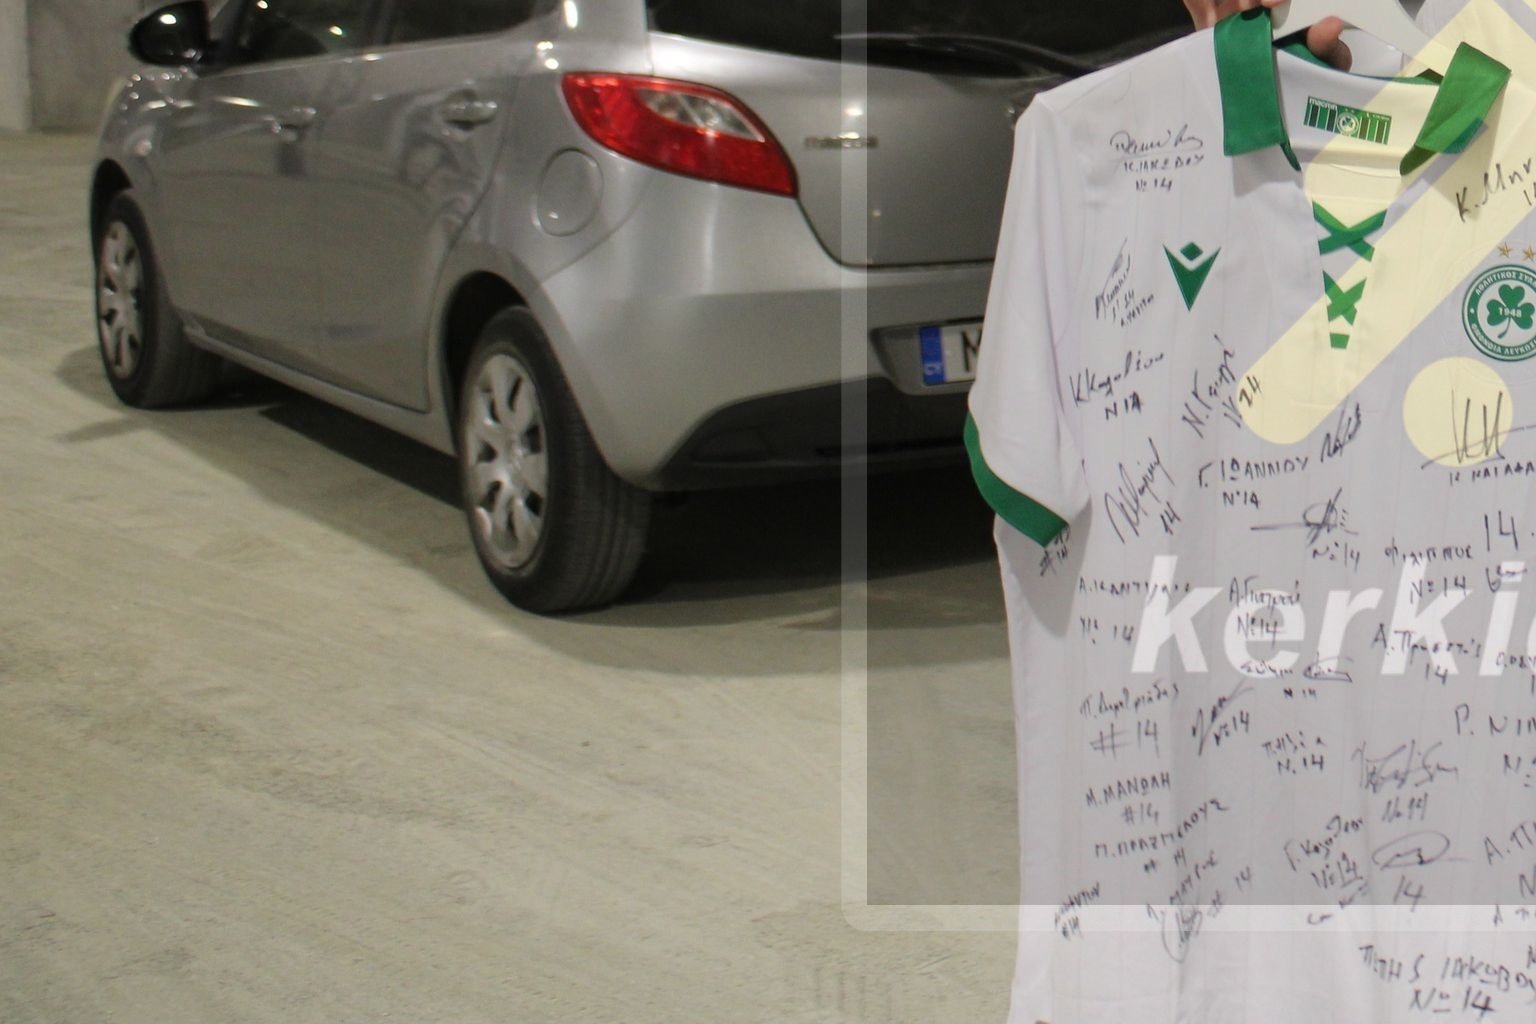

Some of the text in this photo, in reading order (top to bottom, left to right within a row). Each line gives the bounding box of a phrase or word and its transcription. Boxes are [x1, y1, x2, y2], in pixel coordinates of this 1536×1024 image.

[1498, 306, 1523, 319] 1948
[1442, 576, 1467, 598] 14
[1113, 624, 1135, 644] 14
[1425, 662, 1449, 685] 14
[1137, 718, 1160, 759] 14
[1393, 875, 1427, 913] 14
[1461, 985, 1496, 1022] 14
